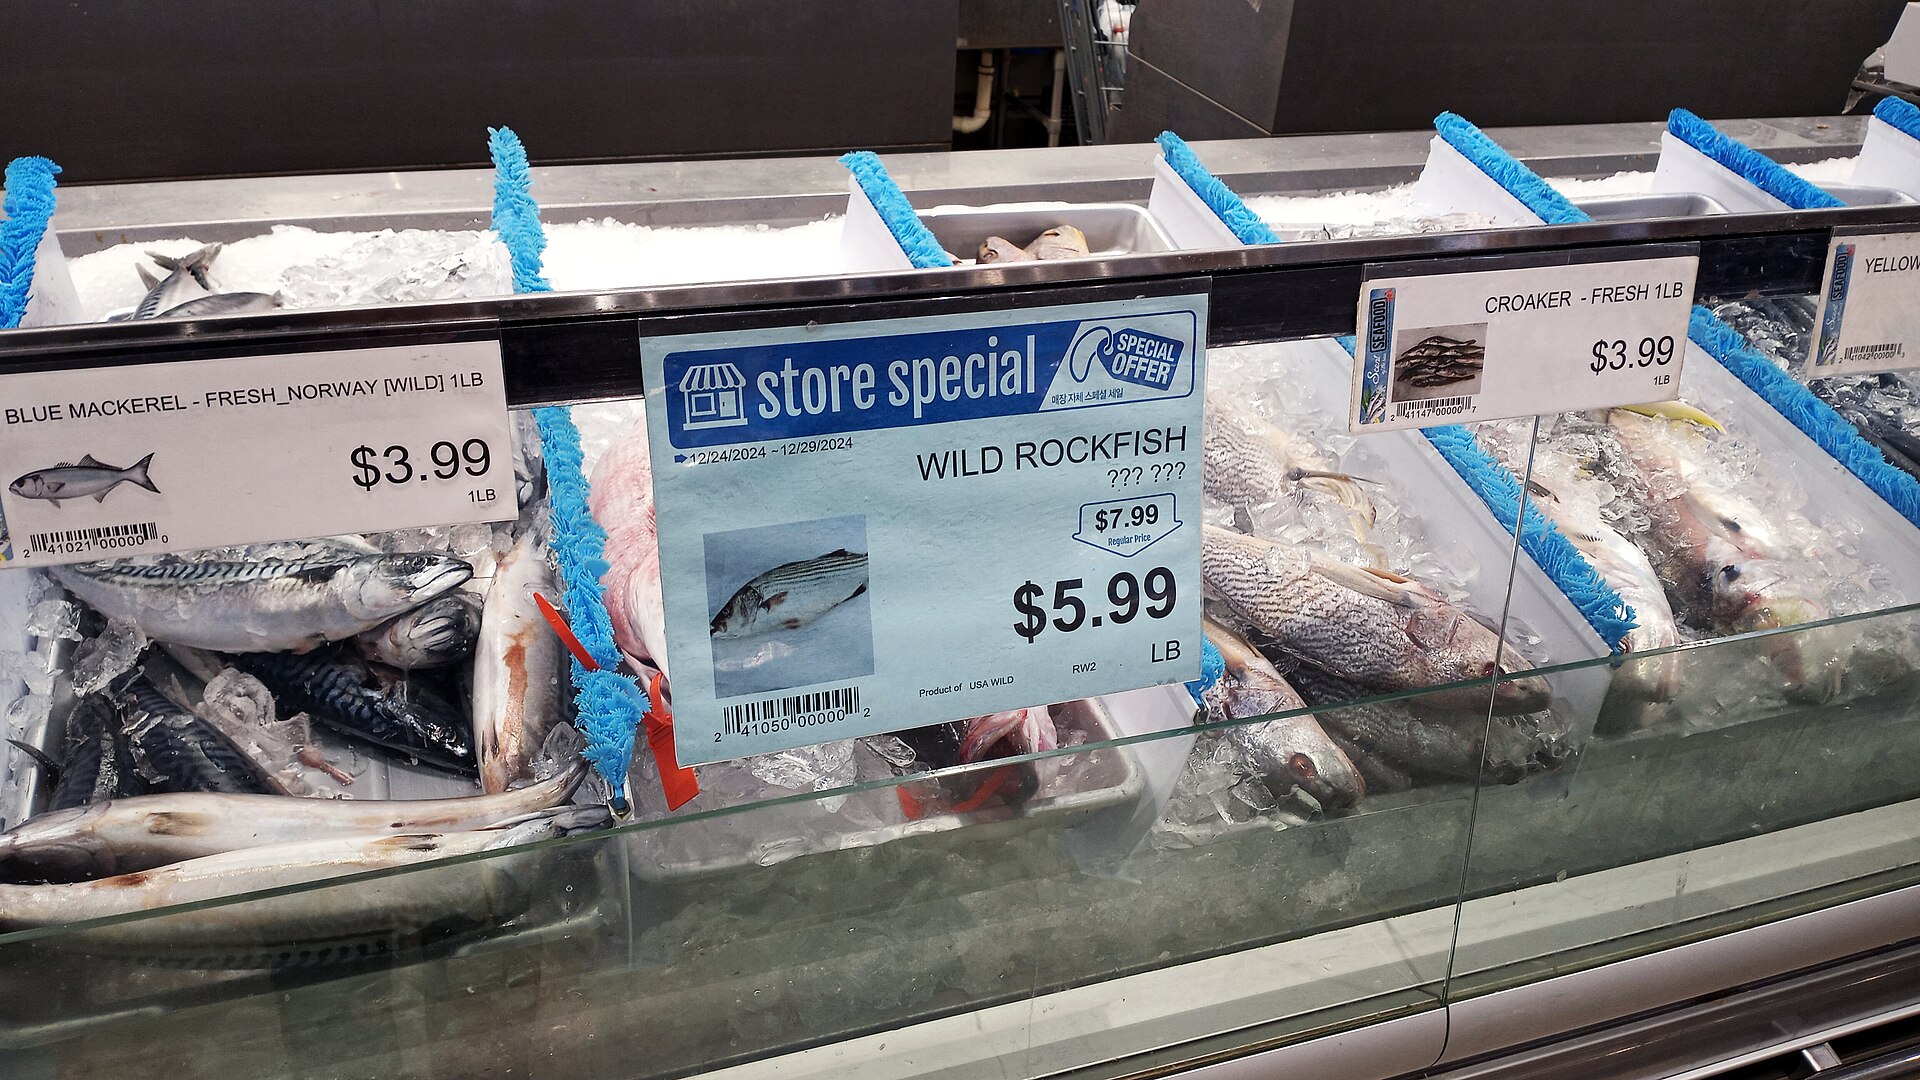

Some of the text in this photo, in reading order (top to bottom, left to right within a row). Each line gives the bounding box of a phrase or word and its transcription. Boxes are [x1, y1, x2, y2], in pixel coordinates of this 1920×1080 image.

[1485, 290, 1571, 313] CROAKER
[1591, 285, 1648, 305] FRESH
[1654, 282, 1683, 299] 1LB
[1372, 301, 1386, 349] SEAFOOD
[1117, 334, 1174, 362] SPECIAL
[1590, 335, 1675, 376] $3.99
[757, 334, 1036, 419] store special
[1111, 353, 1171, 384] OFFER
[1367, 355, 1380, 384] Scent
[1654, 374, 1670, 386] 1LB
[5, 404, 63, 425] BLUE
[68, 395, 187, 419] MACKEREL
[205, 379, 378, 407] FRESH_NORWAY
[384, 375, 445, 396] [WILD]
[450, 372, 484, 388] 1LB
[1405, 409, 1431, 419] 41147
[1436, 406, 1462, 416] 00000
[351, 438, 491, 492] $3.99
[690, 445, 767, 464] 12/24/2024
[916, 425, 1187, 482] WILD ROCKFISH
[1107, 462, 1187, 488] ??? ???
[468, 488, 496, 503] 1LB
[1095, 504, 1159, 533] $7.99
[23, 535, 169, 558] 2 41021 00000 0
[1108, 533, 1151, 548] Regular Price
[1013, 567, 1178, 644] $5.99
[1151, 639, 1181, 664] LB
[1072, 662, 1096, 674] RW2
[919, 676, 1014, 698] Product of USA WILD
[714, 707, 871, 742] 2 41050 00000 2
